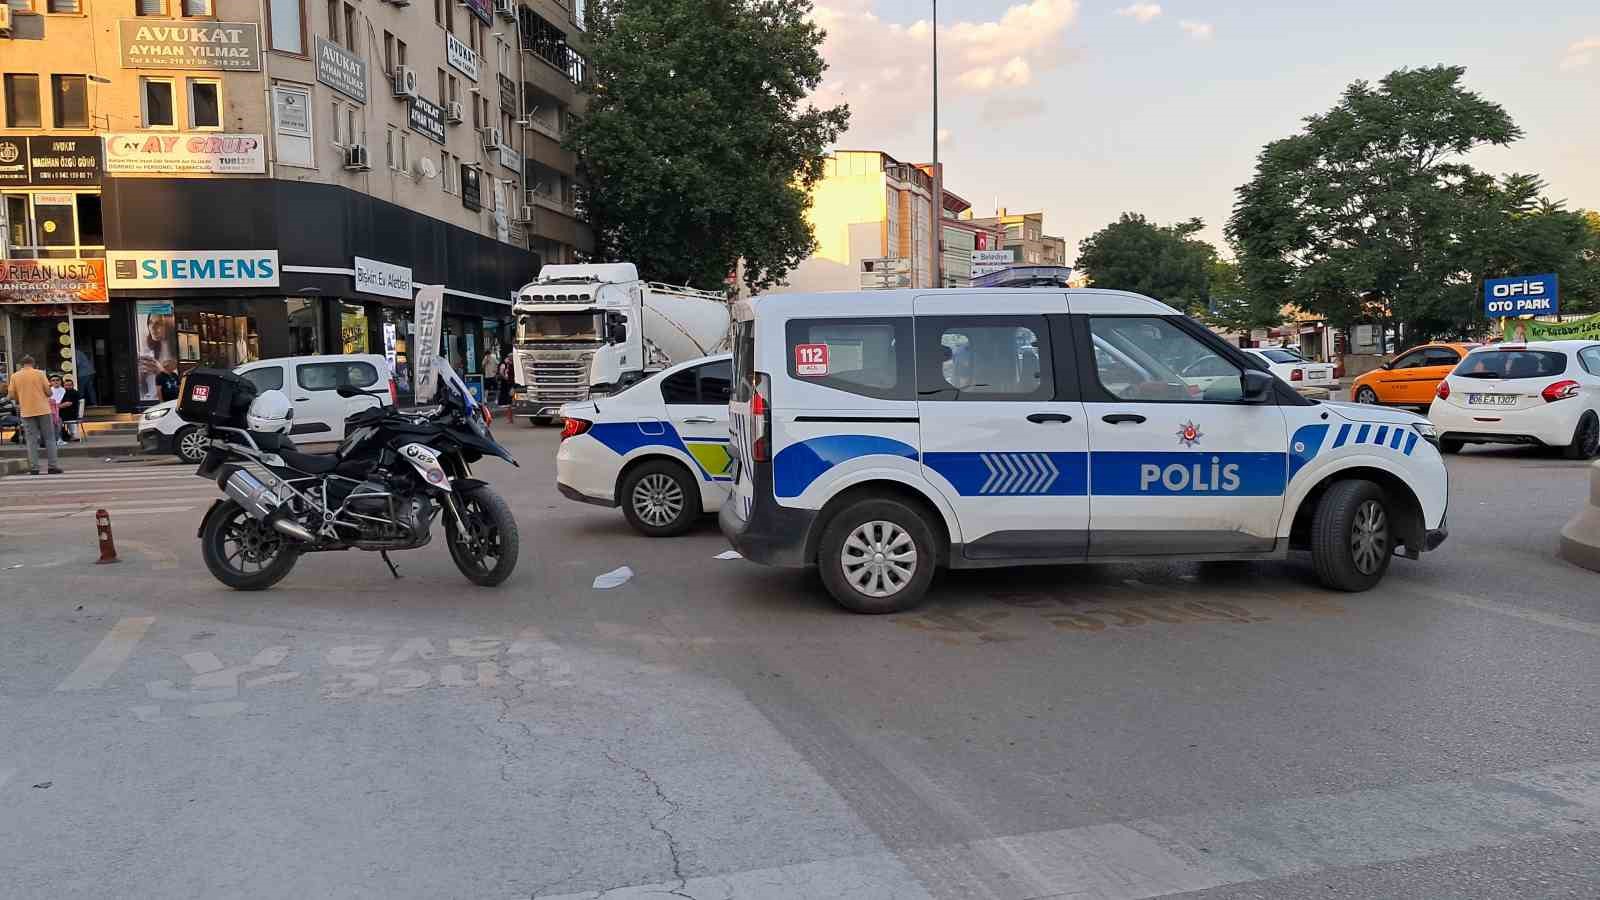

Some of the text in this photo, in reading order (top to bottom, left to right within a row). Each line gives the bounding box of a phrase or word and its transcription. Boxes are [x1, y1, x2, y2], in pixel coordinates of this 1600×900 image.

[136, 26, 242, 43] AVUKAT
[129, 45, 249, 57] AYHAN YILMAZ
[322, 46, 361, 77] AVUKAT
[320, 61, 342, 80] AYHAN
[415, 98, 440, 119] AVUKAT
[52, 142, 76, 151] AVUKAT
[141, 136, 180, 153] AY
[186, 136, 258, 154] GRUP
[57, 263, 97, 280] USTA
[142, 258, 275, 280] SIEMENS
[1493, 280, 1545, 297] OFİS
[1488, 298, 1551, 312] OTO PARK
[418, 301, 435, 385] SIEMENS
[800, 348, 823, 363] 112
[195, 387, 208, 396] 112
[1140, 456, 1240, 491] POLİS
